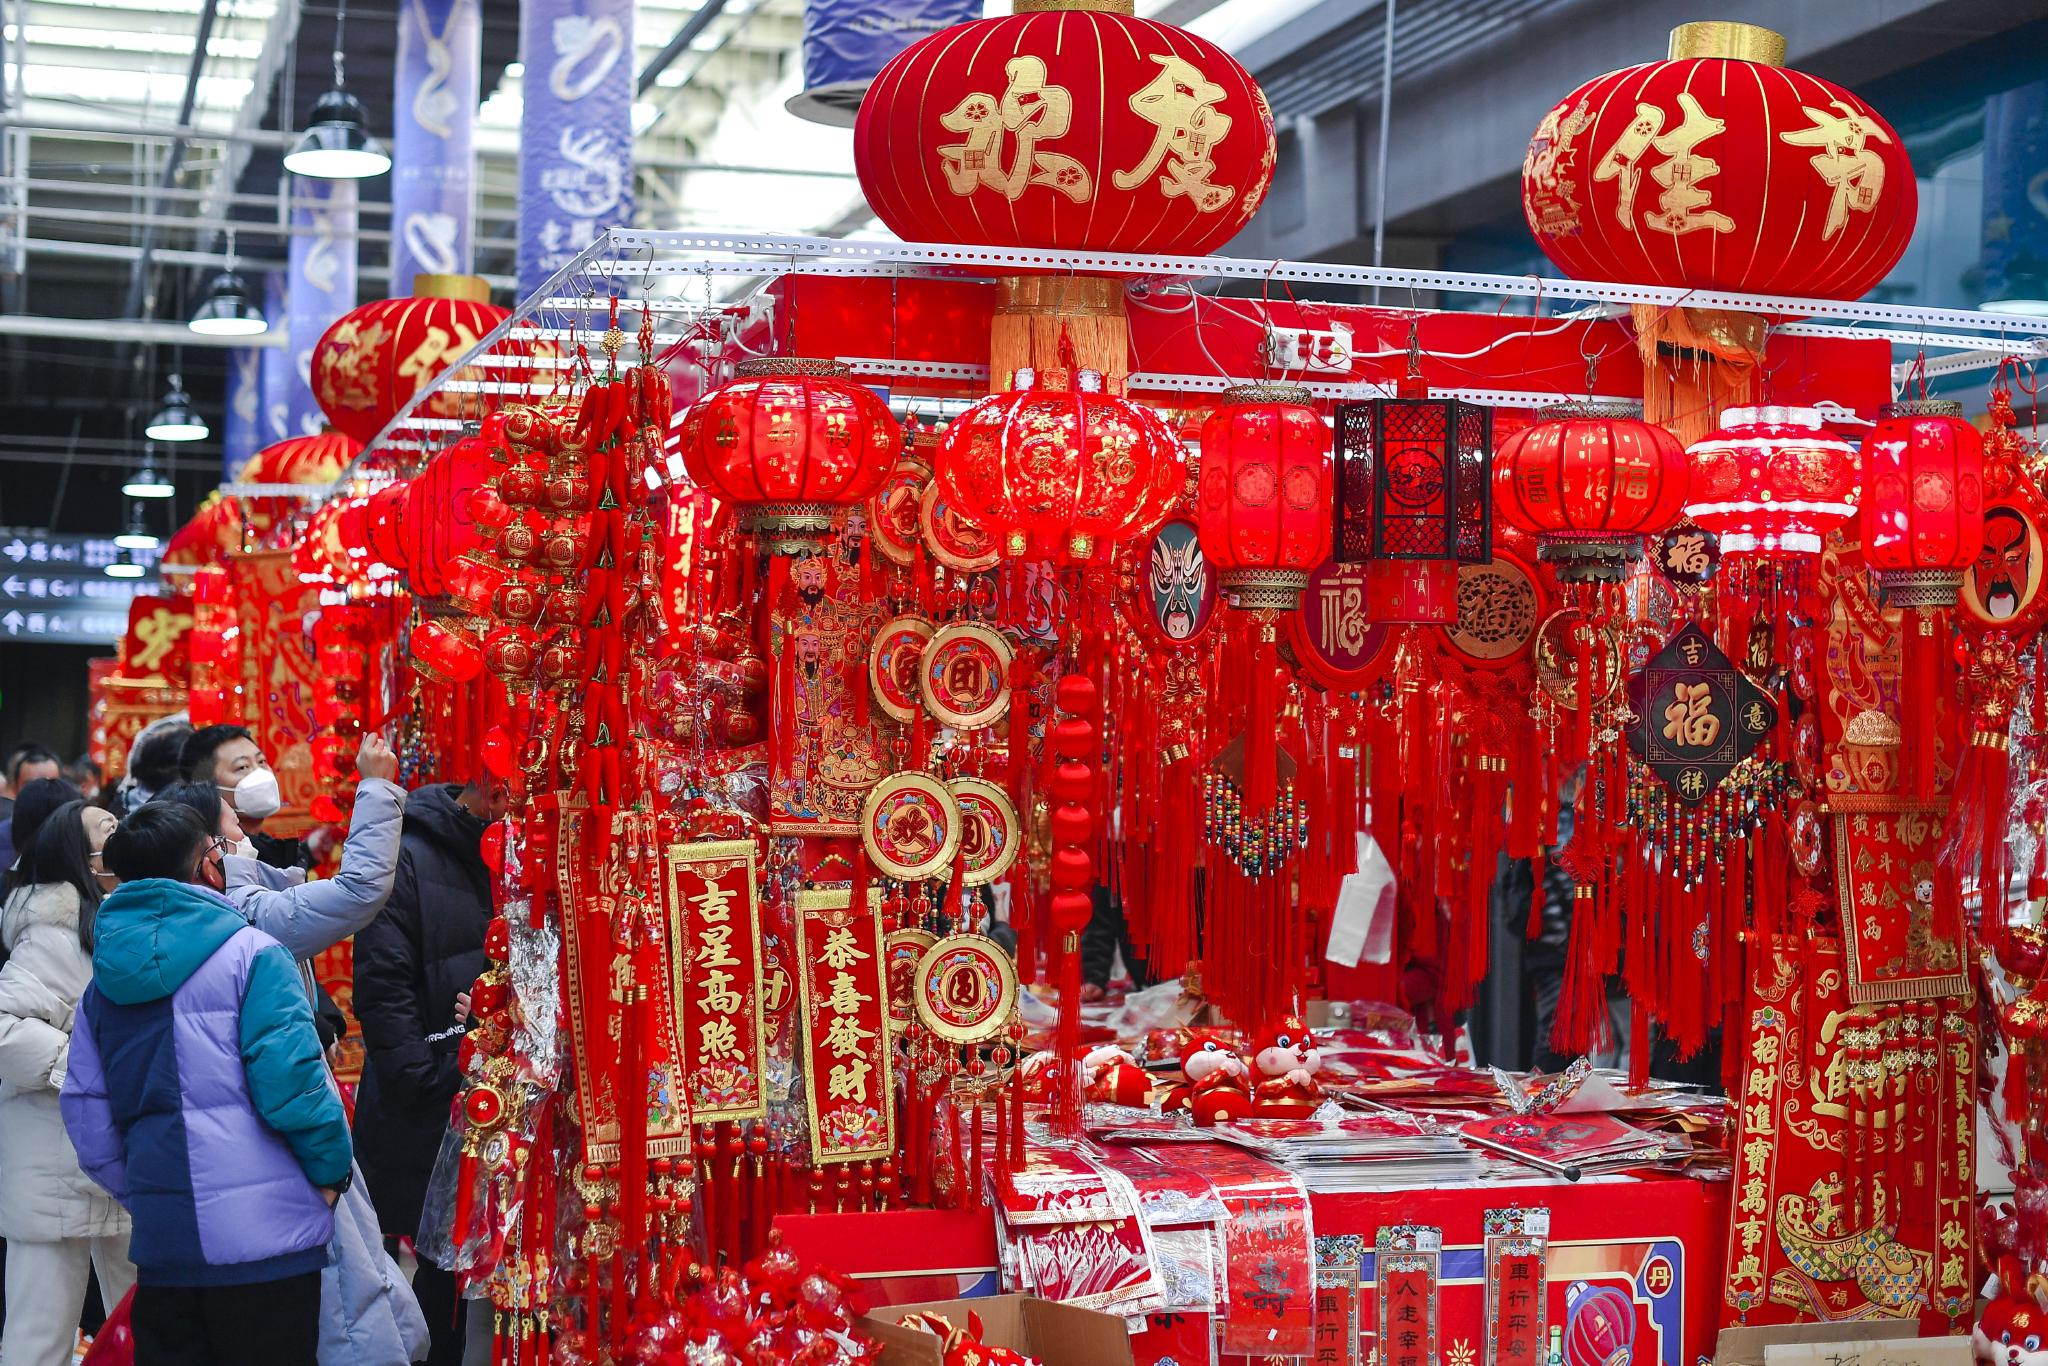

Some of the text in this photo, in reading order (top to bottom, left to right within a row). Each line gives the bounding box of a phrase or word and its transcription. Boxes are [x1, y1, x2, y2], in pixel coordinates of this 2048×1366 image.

[936, 53, 1236, 213] 欢度
[1594, 93, 1893, 241] 佳节
[1613, 457, 1651, 501] 福
[1667, 534, 1710, 574] 福
[1320, 578, 1371, 657] 福
[1681, 637, 1703, 665] 吉
[1662, 682, 1721, 747] 福
[1743, 702, 1767, 731] 意
[1680, 771, 1705, 799] 祥
[889, 808, 931, 850] 欢
[688, 880, 745, 1065] 吉星高照
[816, 927, 876, 1104] 恭喜發財
[1729, 1031, 1779, 1286] 招財進寶萬事興
[1649, 1266, 1670, 1288] 丹
[1831, 1287, 1848, 1308] 福
[1317, 1295, 1340, 1366] 車行平
[1506, 1262, 1531, 1358] 車行平安
